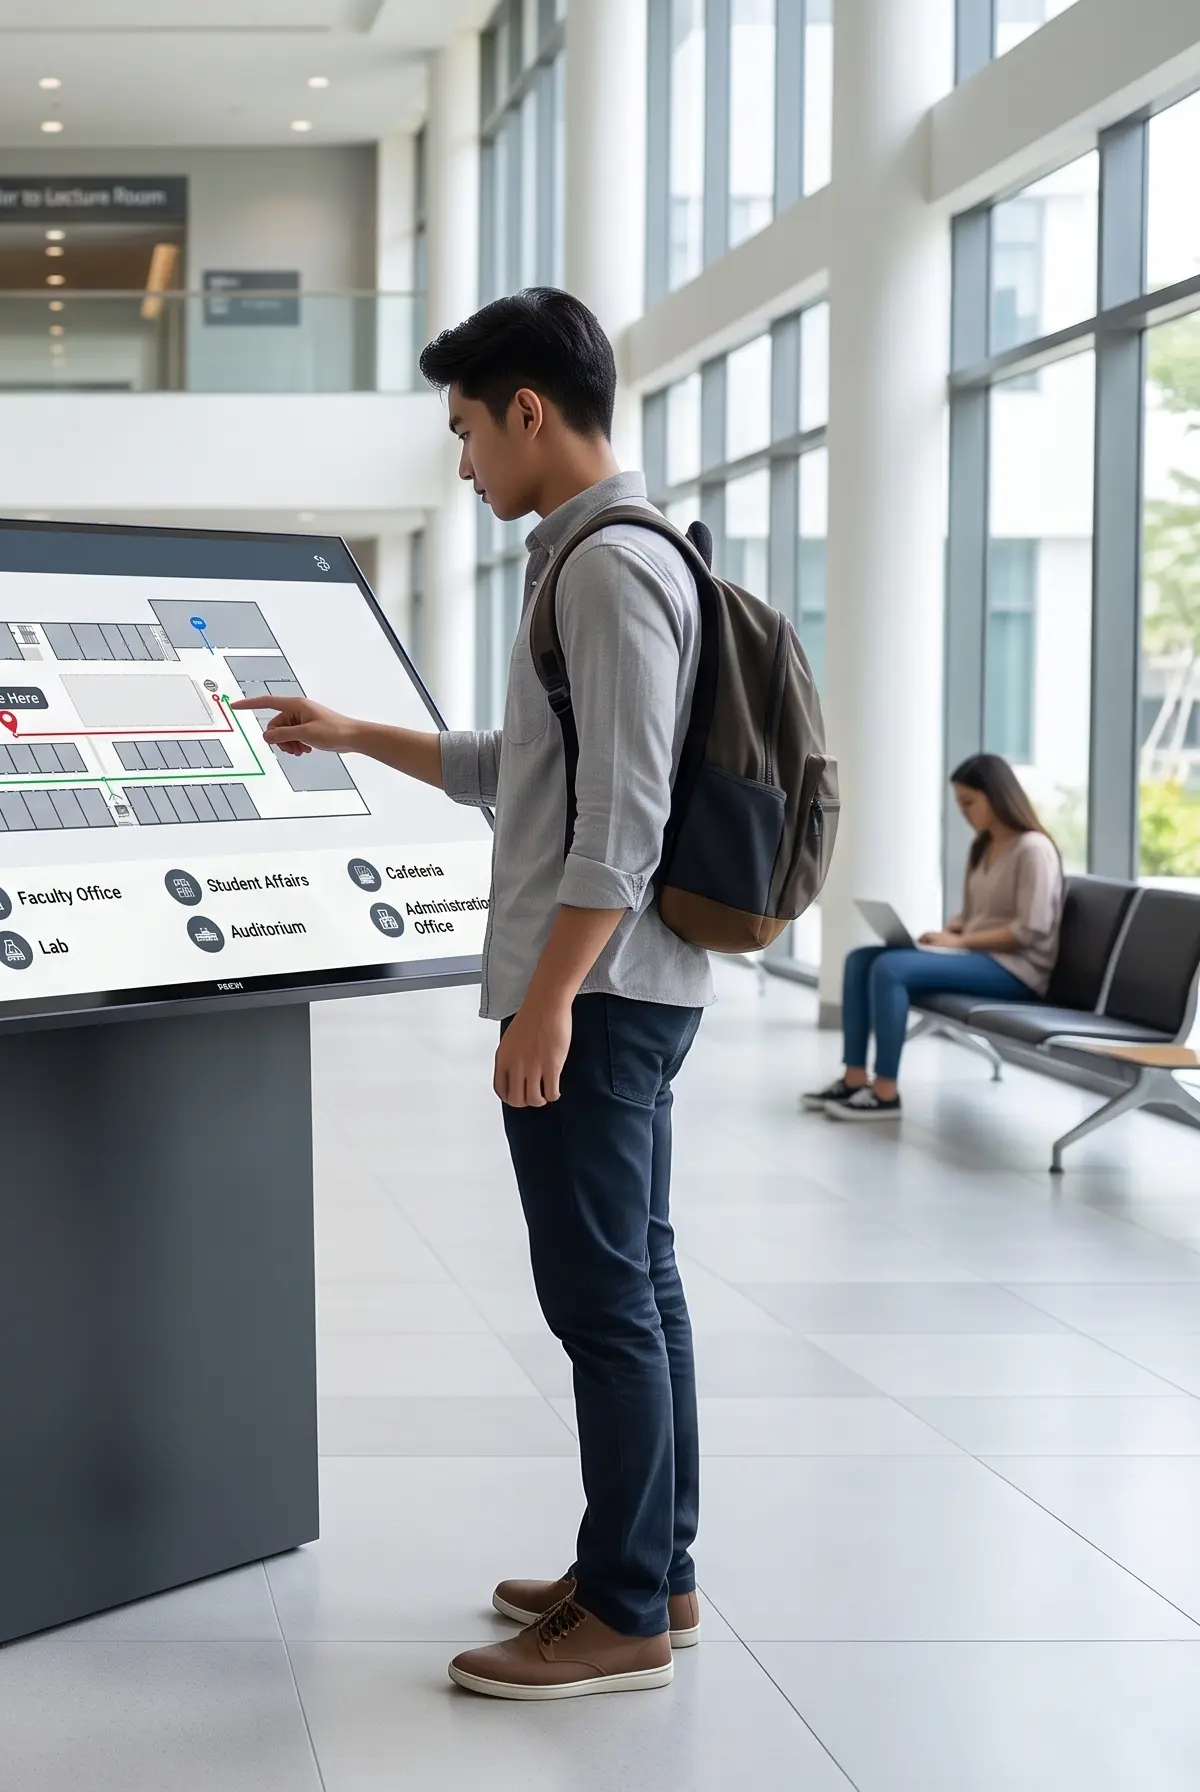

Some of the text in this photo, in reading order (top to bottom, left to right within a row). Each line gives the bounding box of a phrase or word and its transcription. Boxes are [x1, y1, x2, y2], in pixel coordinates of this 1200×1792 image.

[112, 185, 167, 207] Room
[6, 692, 40, 704] Here
[385, 863, 445, 880] Cafeteria
[206, 873, 310, 893] Student Affairs
[17, 885, 123, 907] Faculty Office
[405, 897, 490, 915] Administratio
[231, 919, 307, 939] Auditorium
[414, 919, 455, 934] Office
[38, 938, 70, 956] Lab
